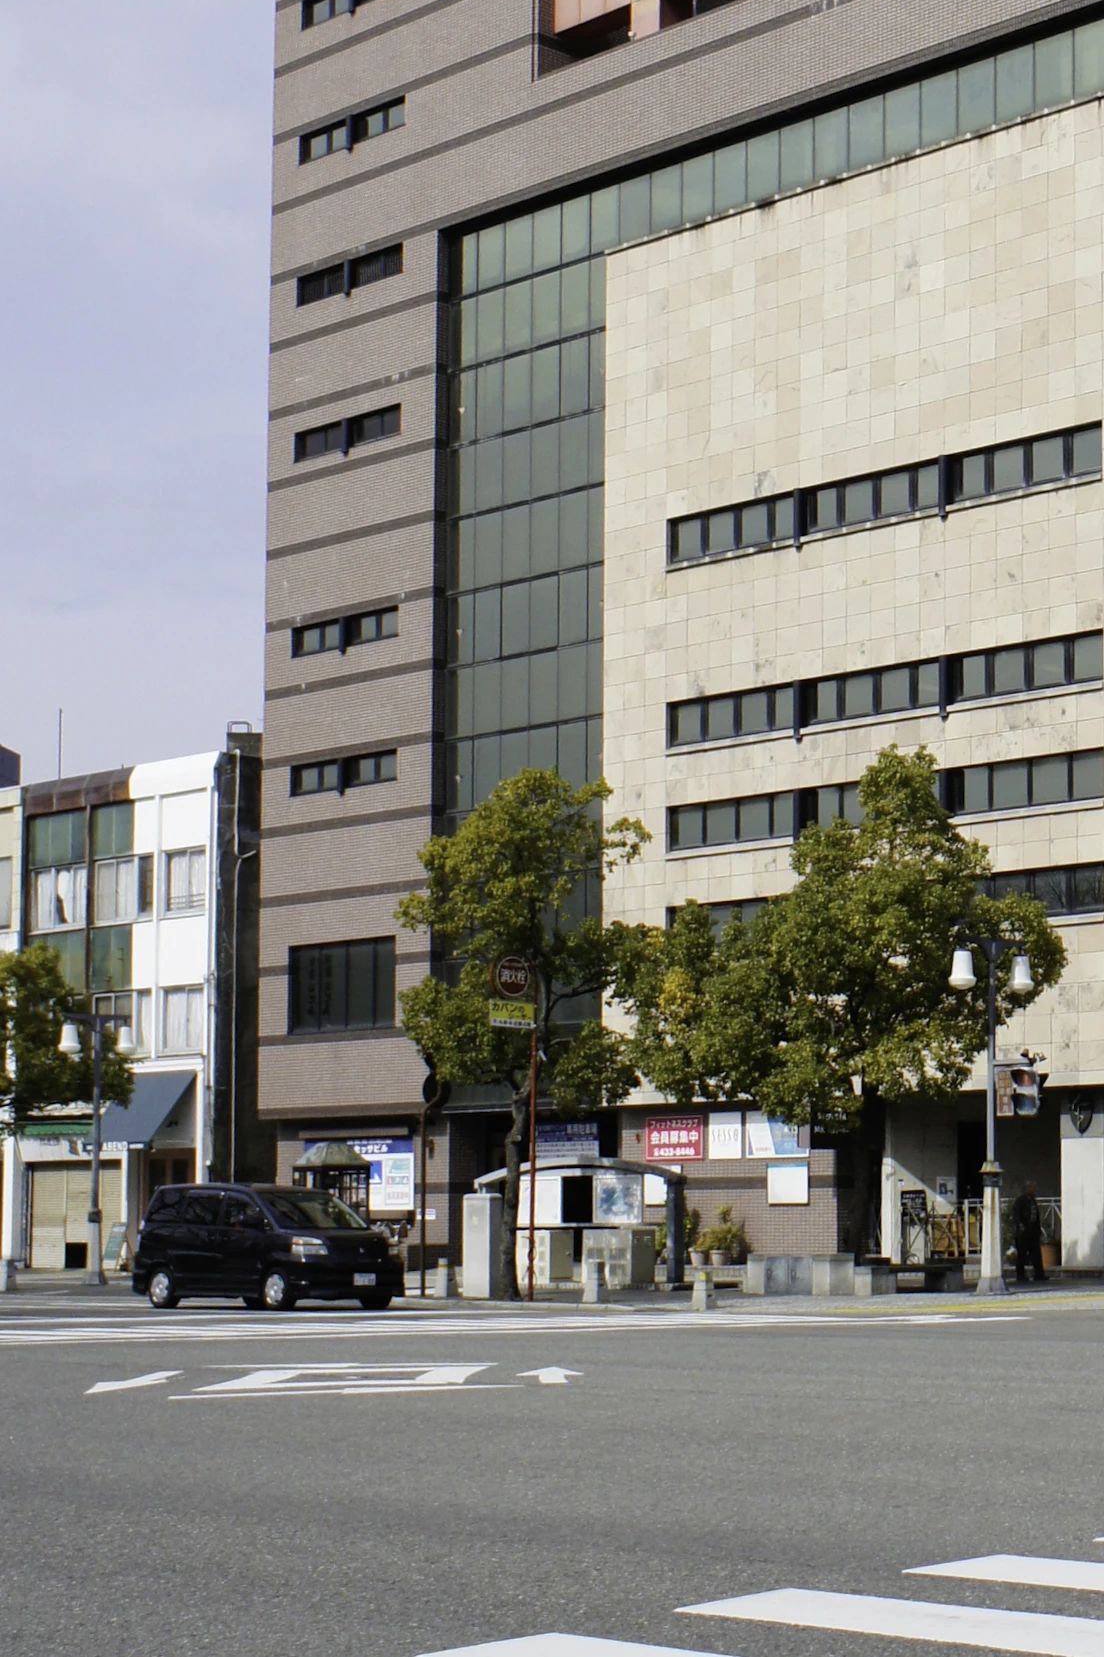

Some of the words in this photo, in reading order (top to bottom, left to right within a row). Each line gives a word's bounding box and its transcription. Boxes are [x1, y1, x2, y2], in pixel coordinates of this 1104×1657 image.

[650, 1129, 699, 1145] 会員募集中
